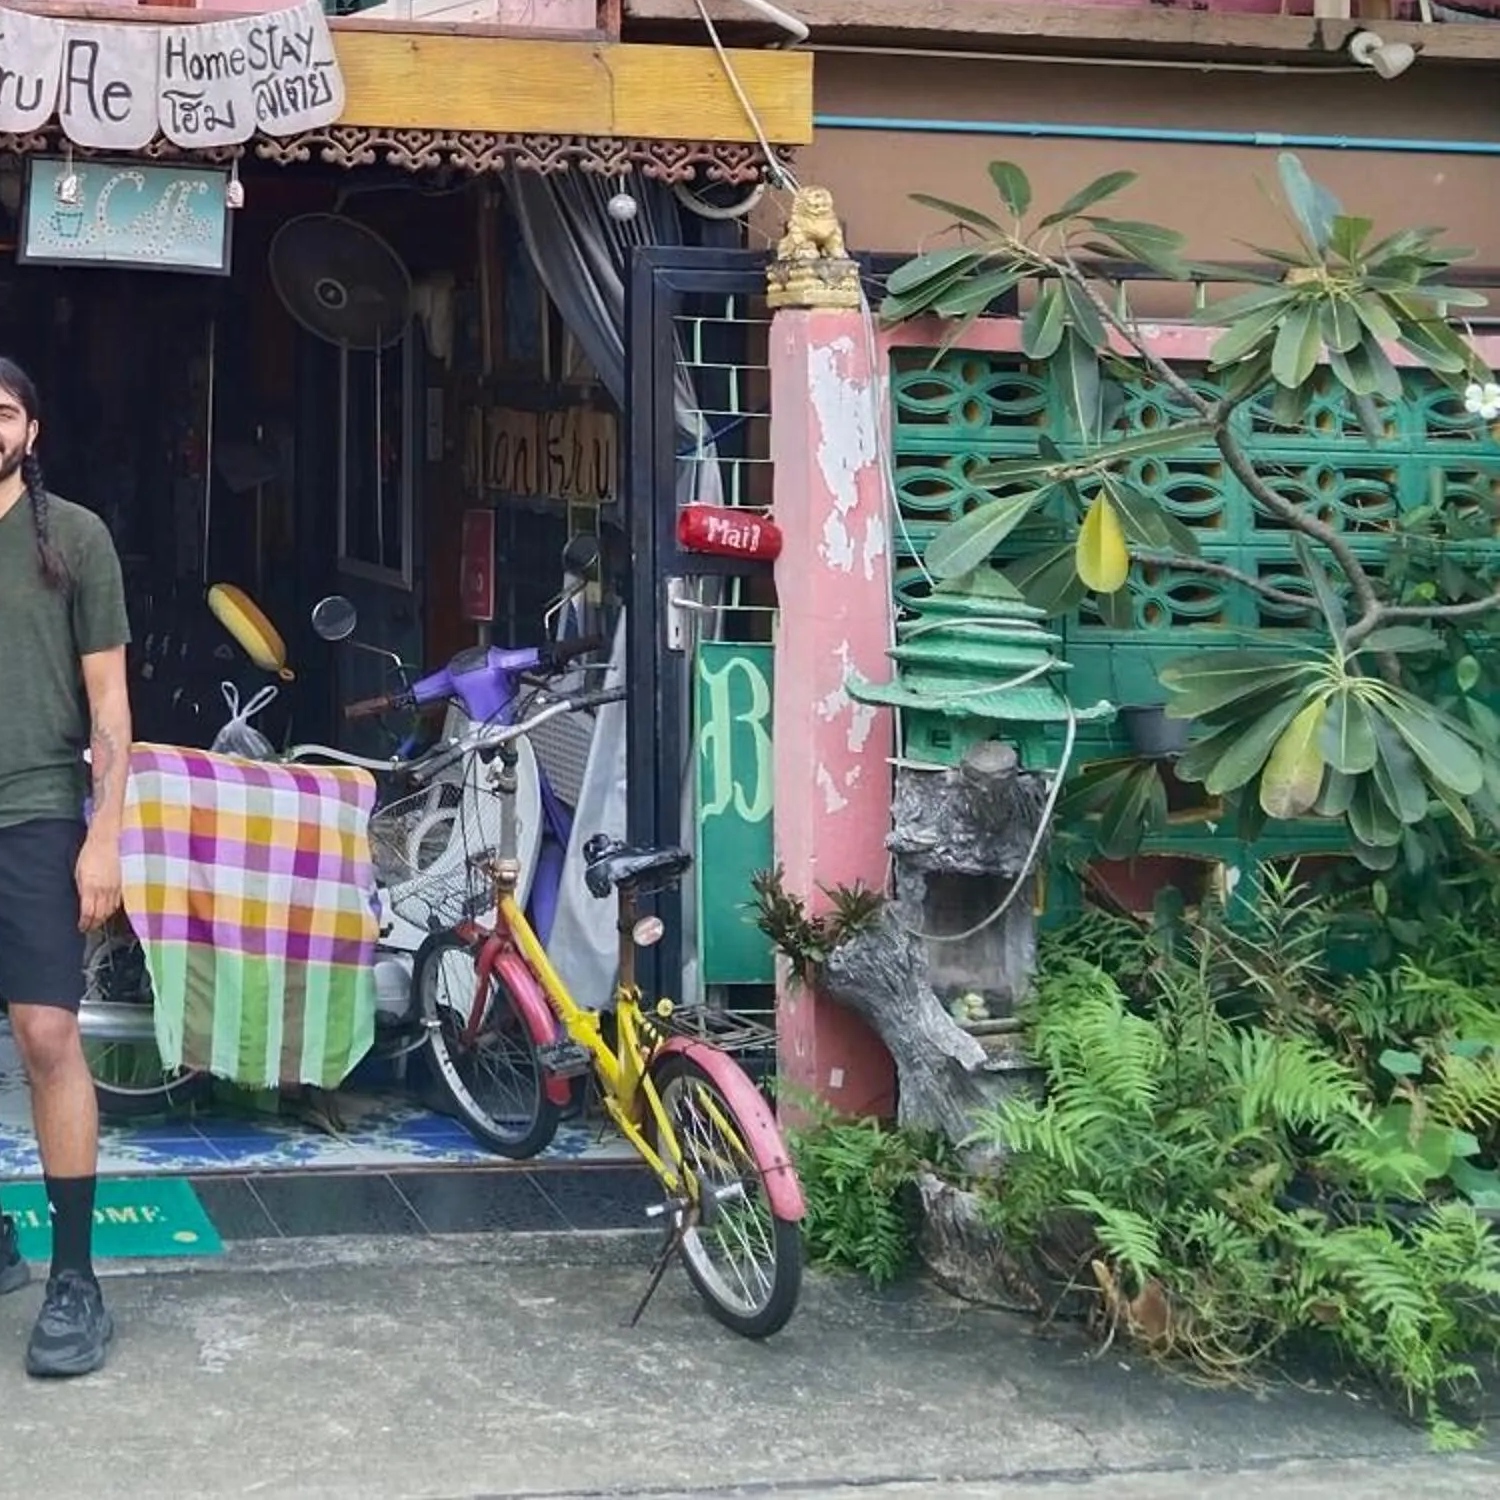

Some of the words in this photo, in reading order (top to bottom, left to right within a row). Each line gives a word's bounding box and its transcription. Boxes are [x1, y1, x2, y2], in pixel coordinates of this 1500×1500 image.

[63, 38, 133, 123] Ae
[707, 516, 761, 553] Mail
[700, 656, 775, 824] B
